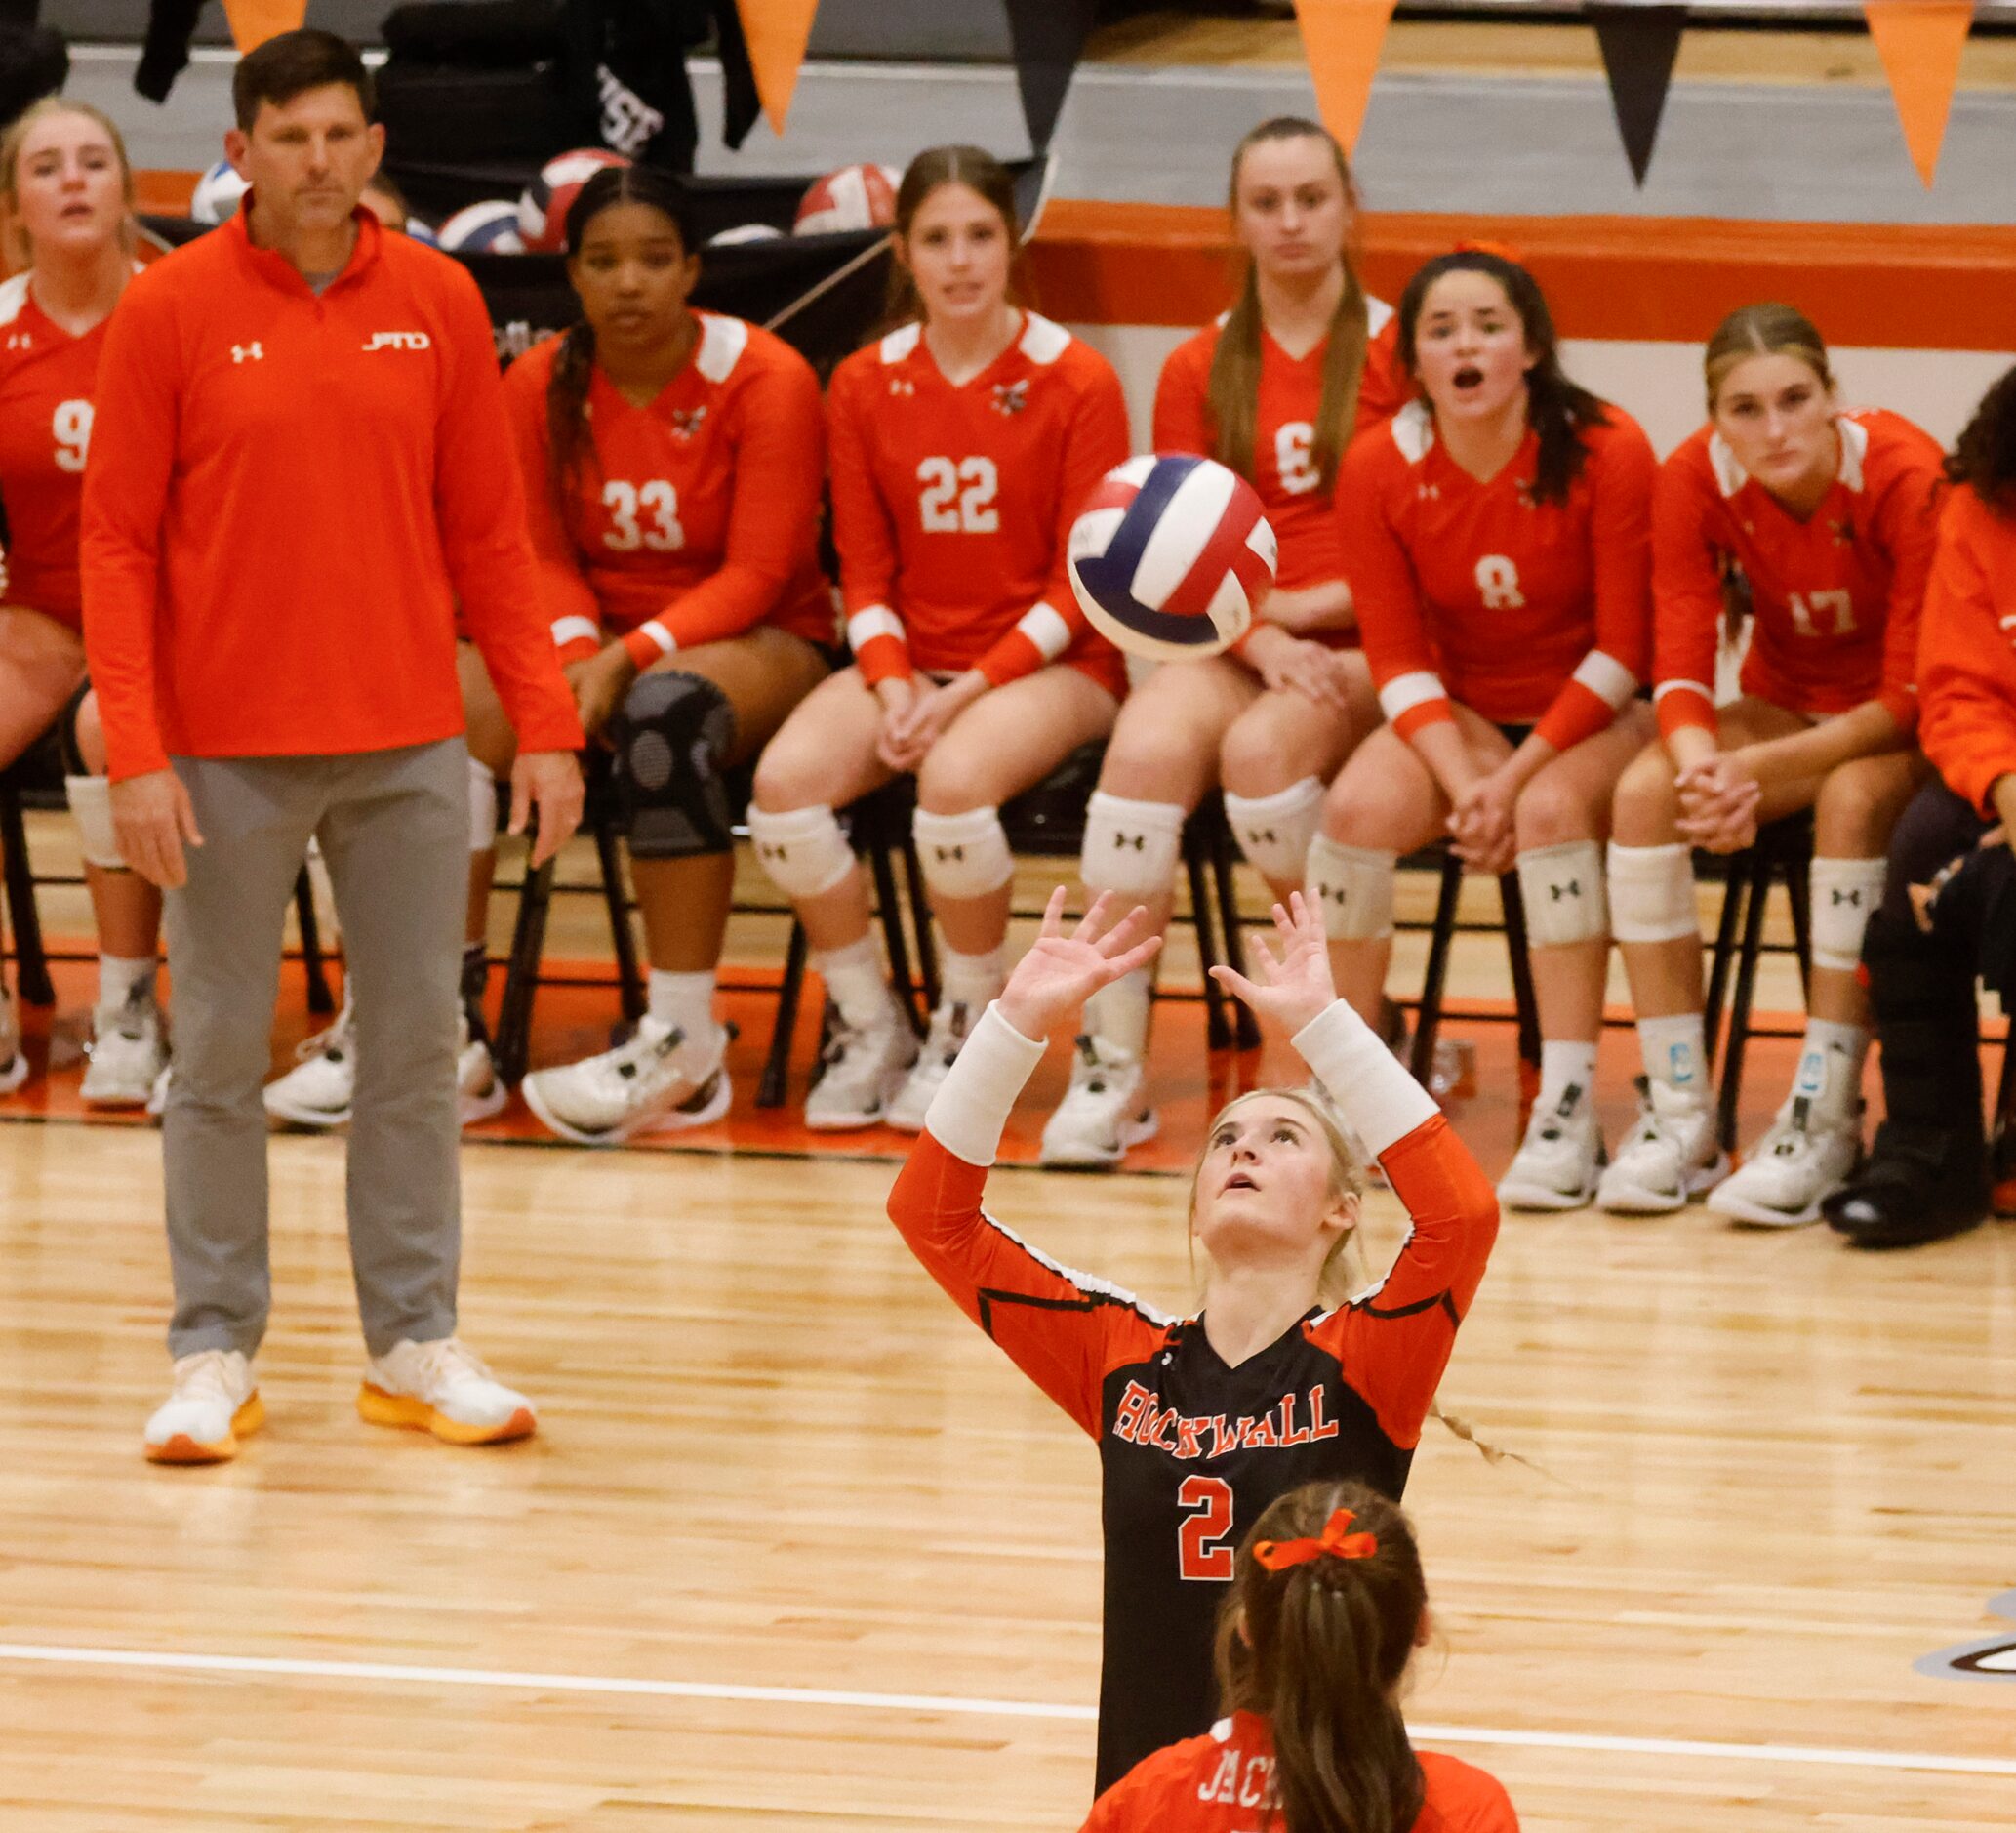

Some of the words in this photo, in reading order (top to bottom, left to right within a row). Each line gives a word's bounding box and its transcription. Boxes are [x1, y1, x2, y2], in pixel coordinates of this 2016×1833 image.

[53, 398, 95, 472] 9
[1275, 421, 1320, 496] 6
[602, 479, 685, 551] 33
[916, 456, 999, 534] 22
[1788, 588, 1856, 636] 17
[1112, 1379, 1340, 1460] ROCKWALL
[1177, 1474, 1235, 1582] 2
